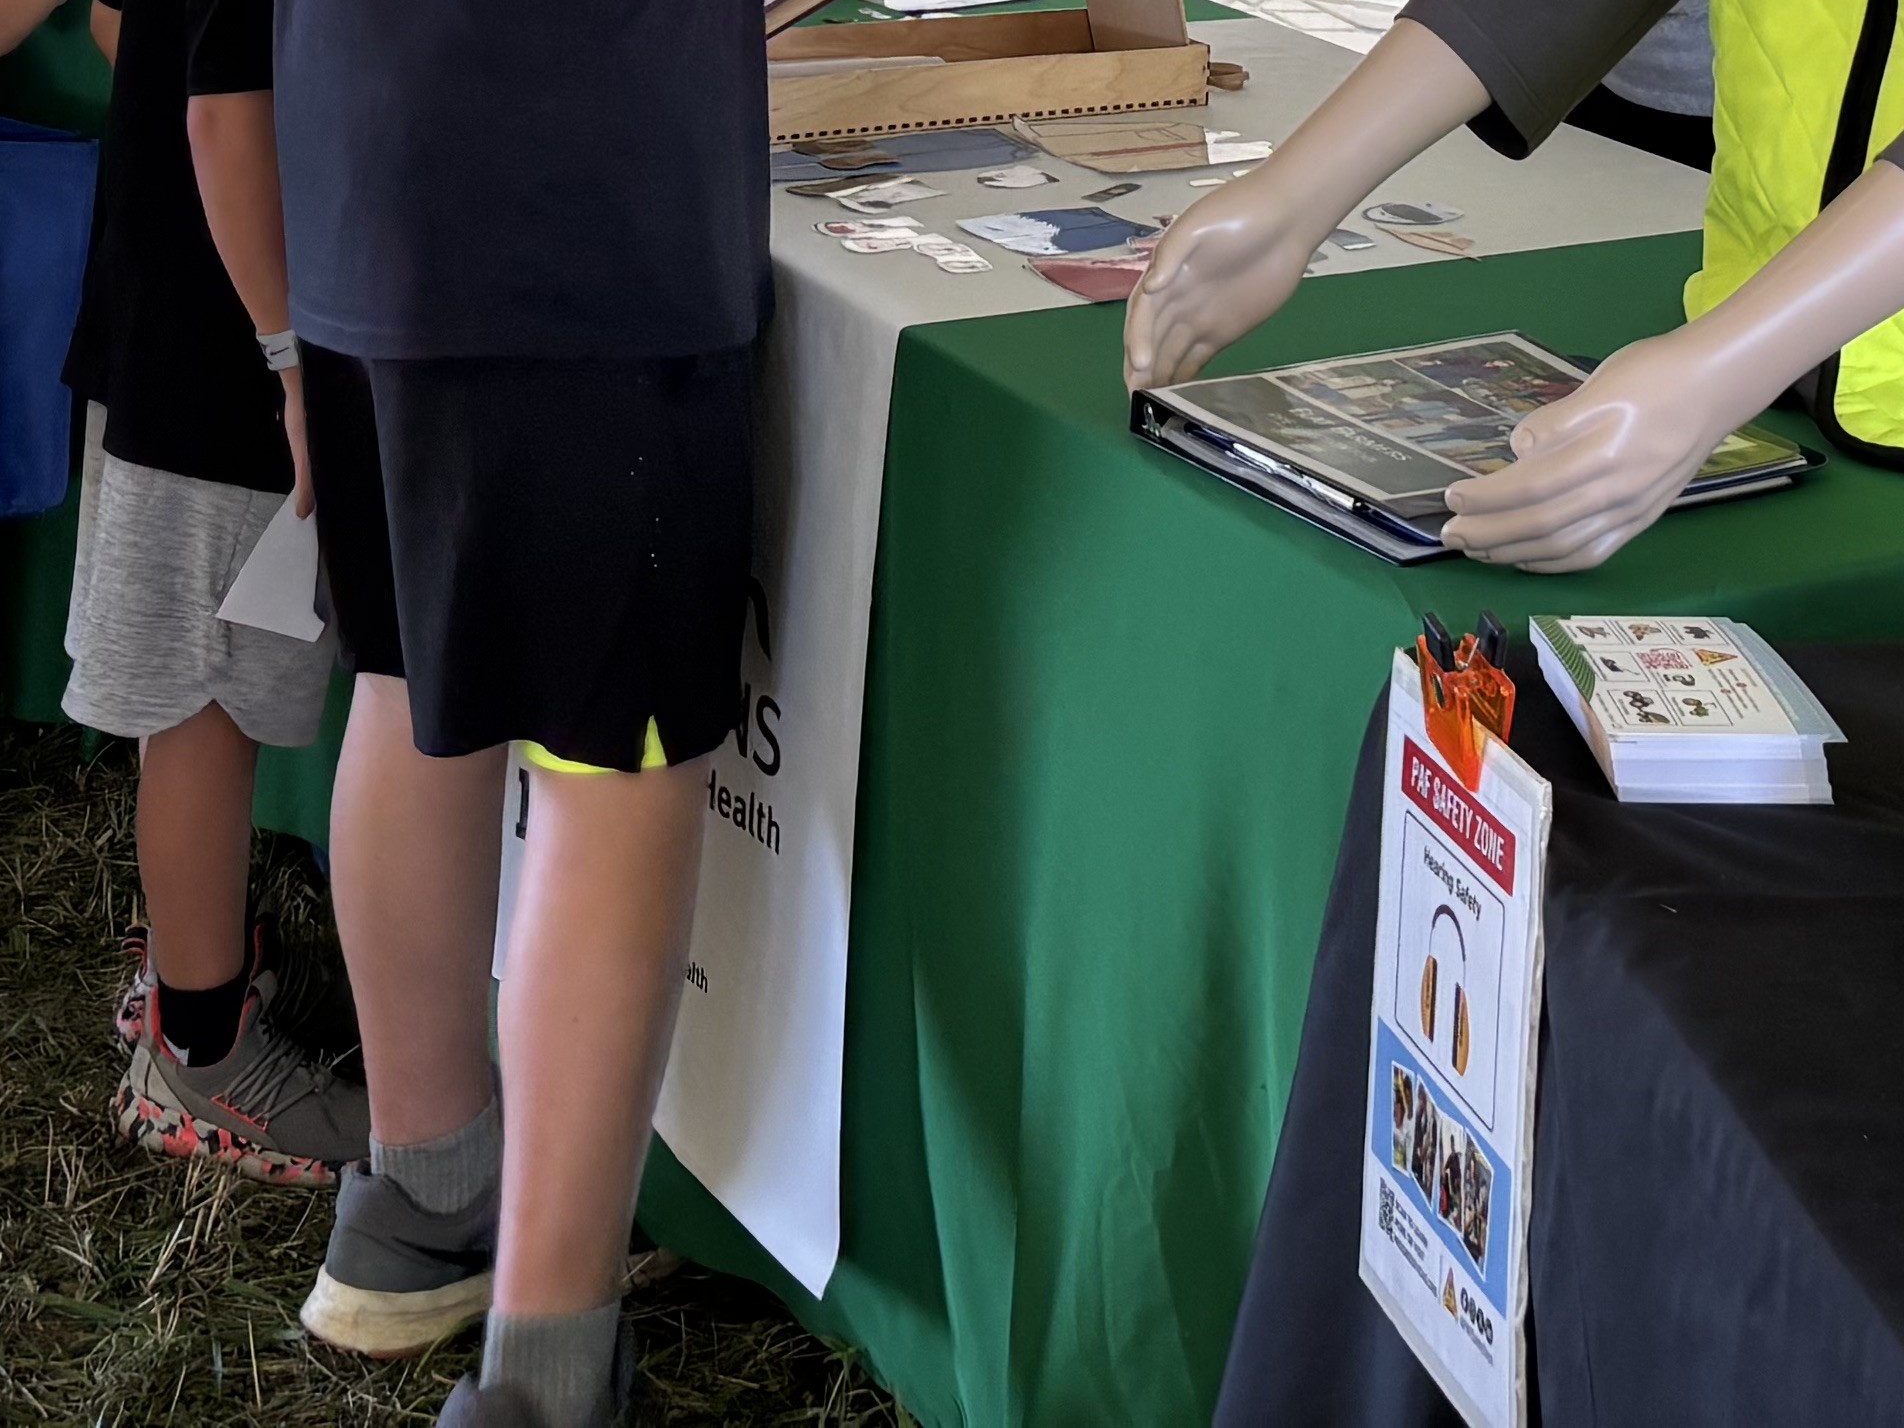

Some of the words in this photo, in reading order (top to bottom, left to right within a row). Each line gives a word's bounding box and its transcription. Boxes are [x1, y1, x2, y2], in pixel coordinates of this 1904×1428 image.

[1411, 756, 1433, 800] PAF
[1432, 777, 1474, 840] SAFETY
[1473, 815, 1505, 872] ZONE
[1423, 845, 1454, 896] Hearing
[1455, 877, 1483, 922] Safety
